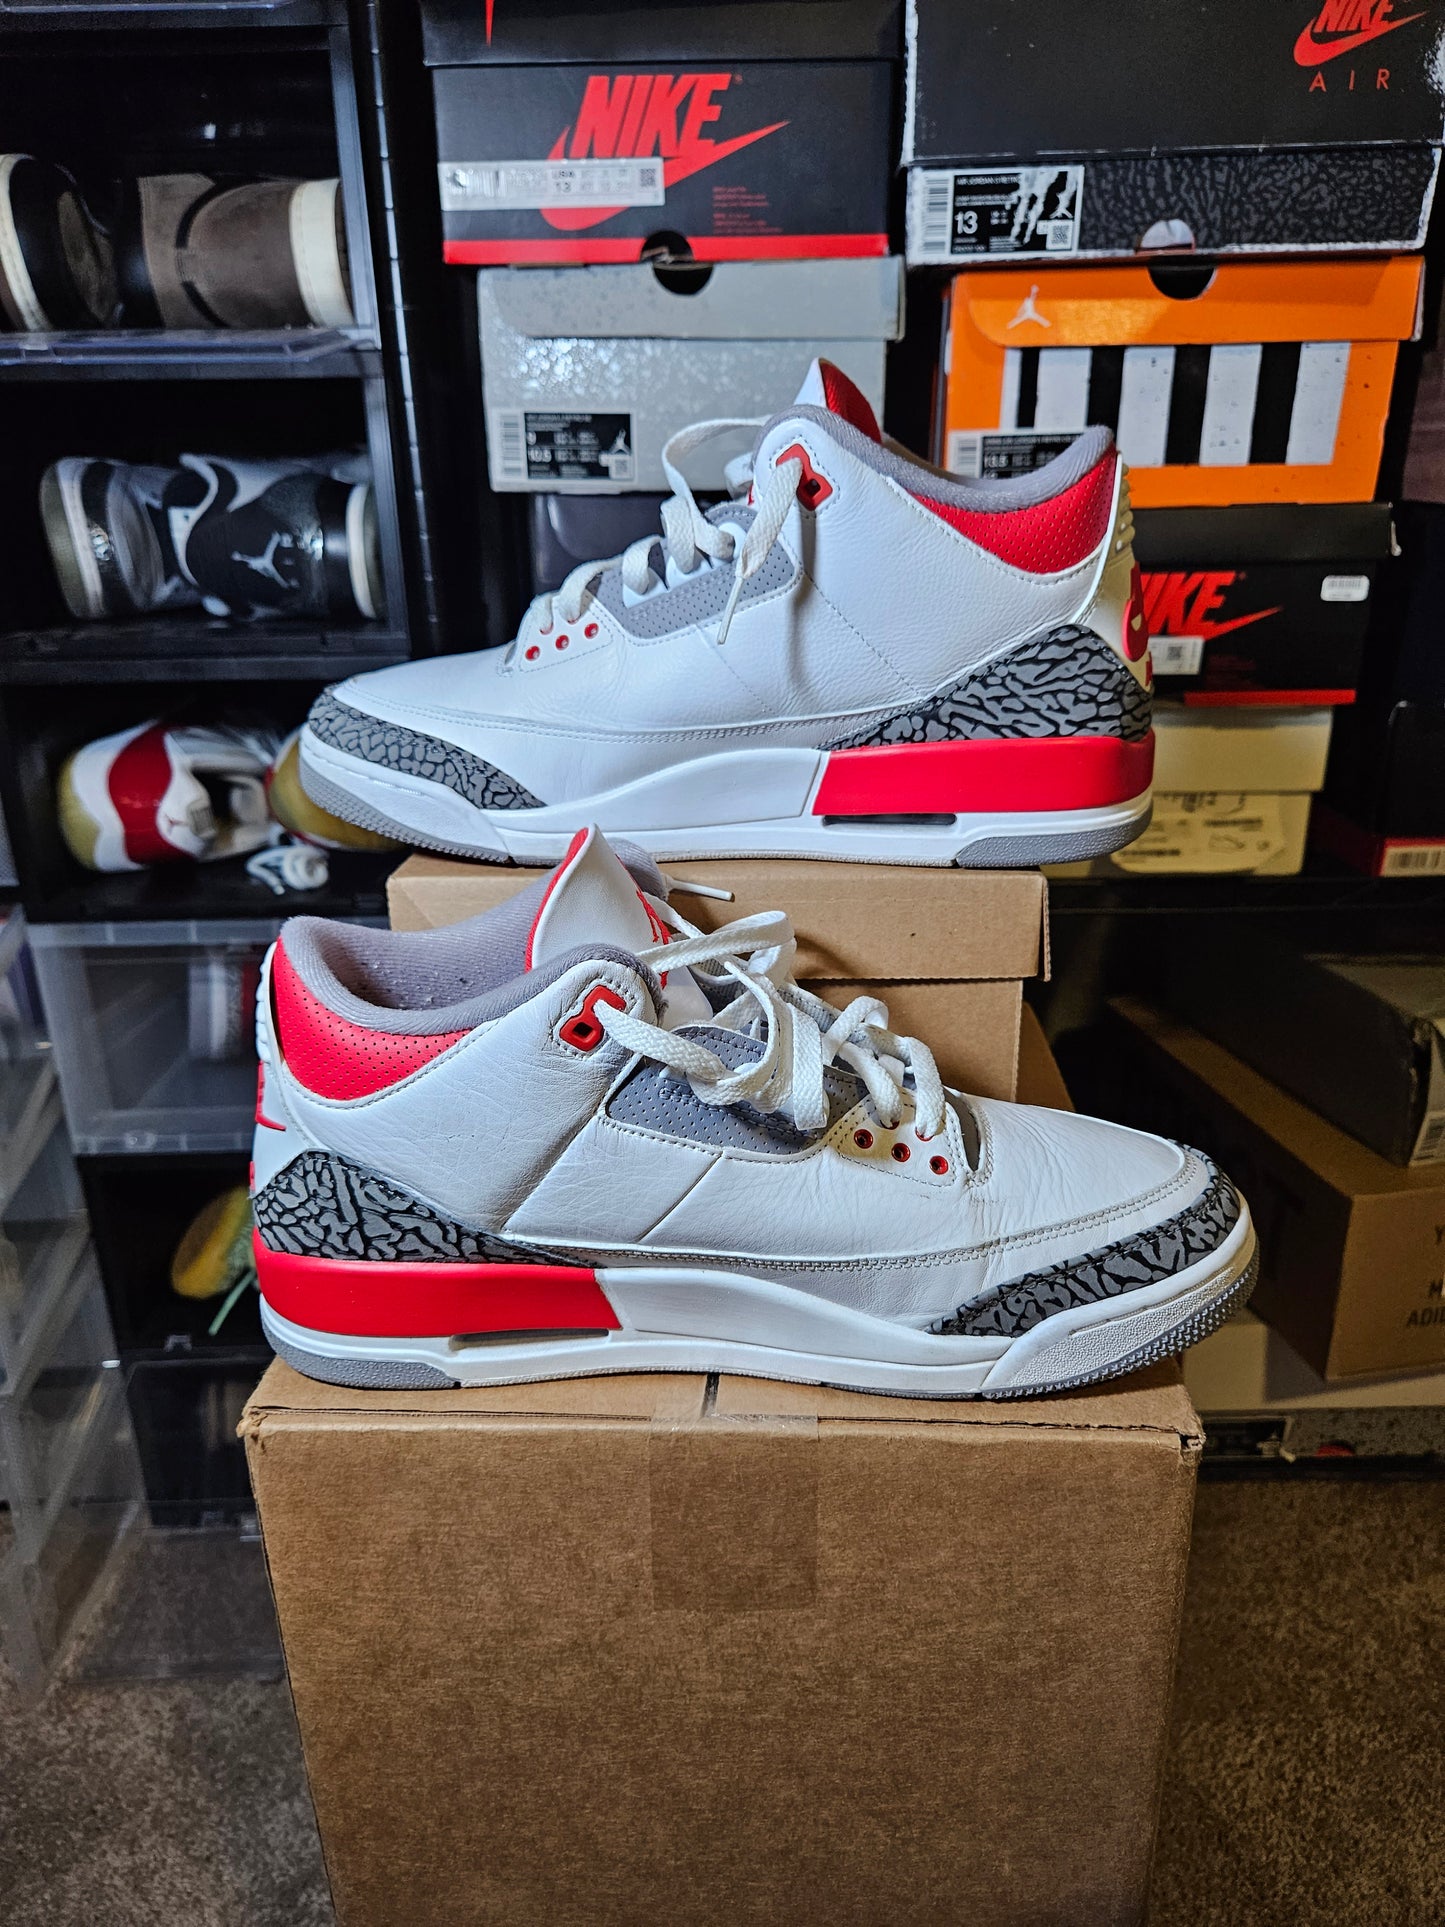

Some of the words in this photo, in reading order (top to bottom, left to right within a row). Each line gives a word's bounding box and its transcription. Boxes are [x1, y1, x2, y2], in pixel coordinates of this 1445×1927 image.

[1313, 0, 1394, 33] NIKE
[1308, 68, 1391, 93] AIR
[569, 73, 733, 159] NIKE
[954, 210, 978, 234] 13
[1140, 571, 1236, 636] IKE
